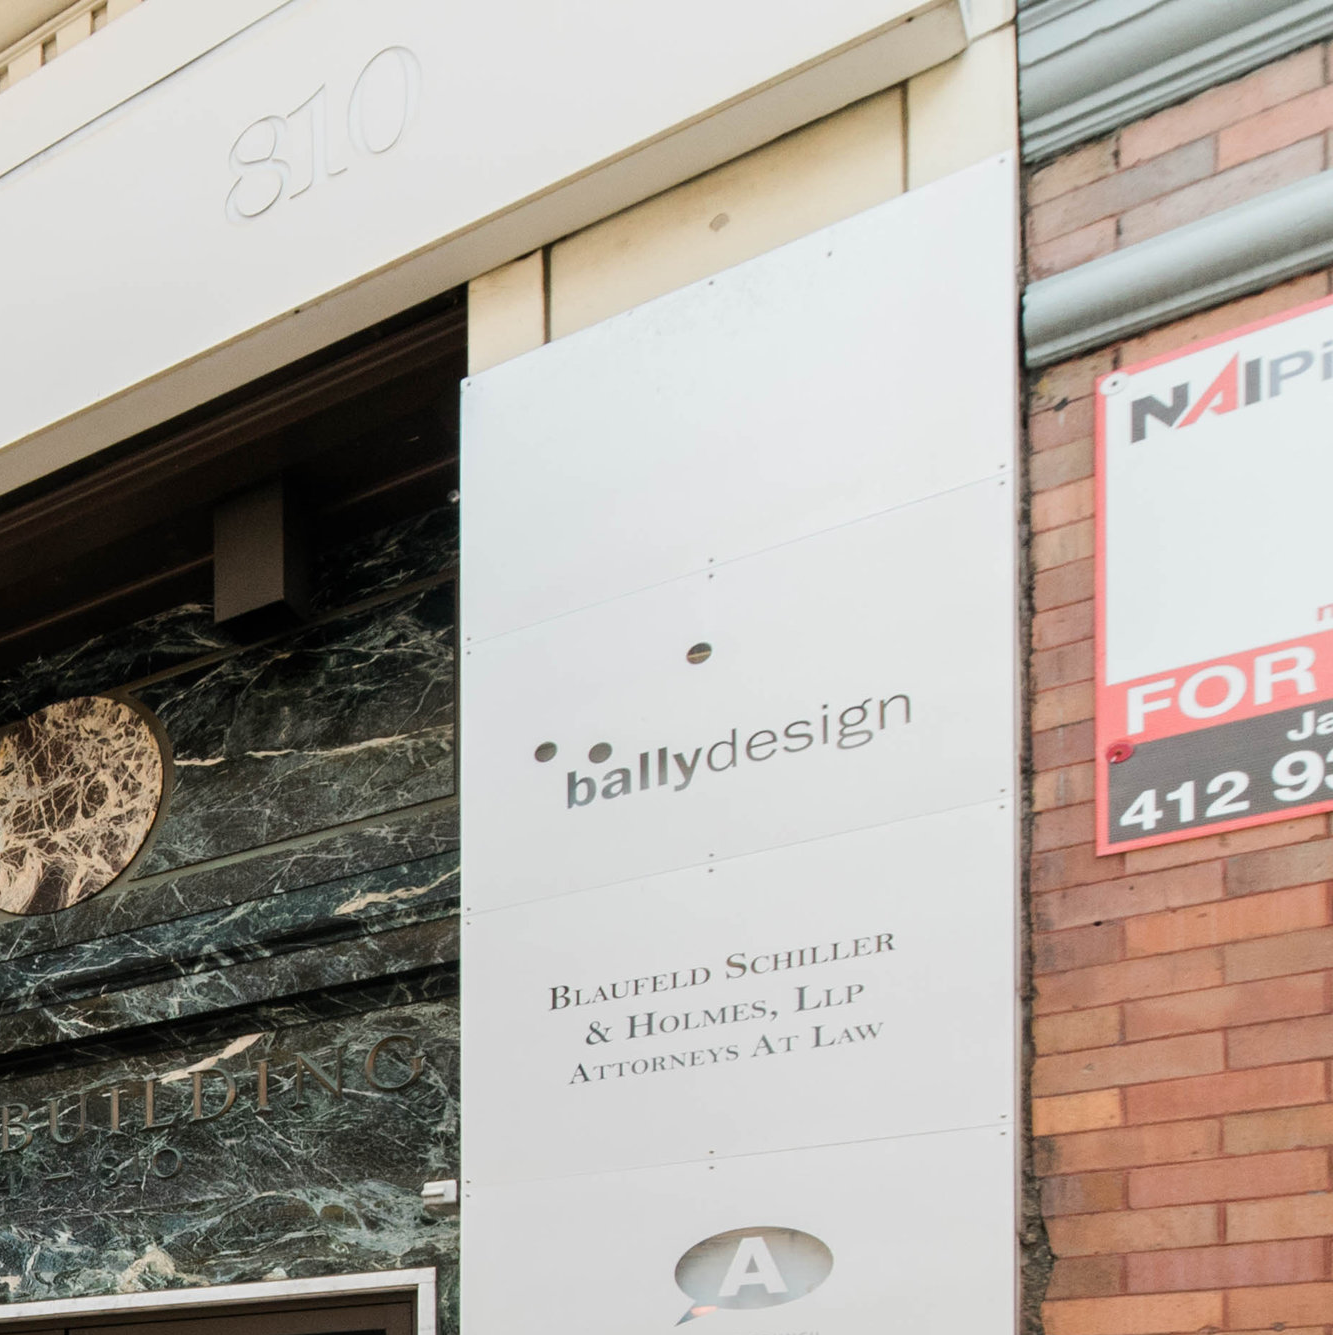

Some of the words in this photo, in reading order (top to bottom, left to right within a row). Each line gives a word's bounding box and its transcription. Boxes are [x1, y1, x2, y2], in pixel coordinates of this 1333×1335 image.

[226, 44, 423, 224] 810
[1127, 646, 1317, 735] FOR
[567, 692, 912, 809] ballydesign
[1119, 771, 1250, 831] 412
[548, 965, 712, 1012] BLAUFELD
[724, 931, 897, 981] SCHILLER
[568, 1042, 740, 1086] ATTORNEYS
[812, 1020, 885, 1050] LAW
[585, 1019, 613, 1046] &
[1, 1033, 427, 1154] BUILDING
[718, 1236, 788, 1297] A
